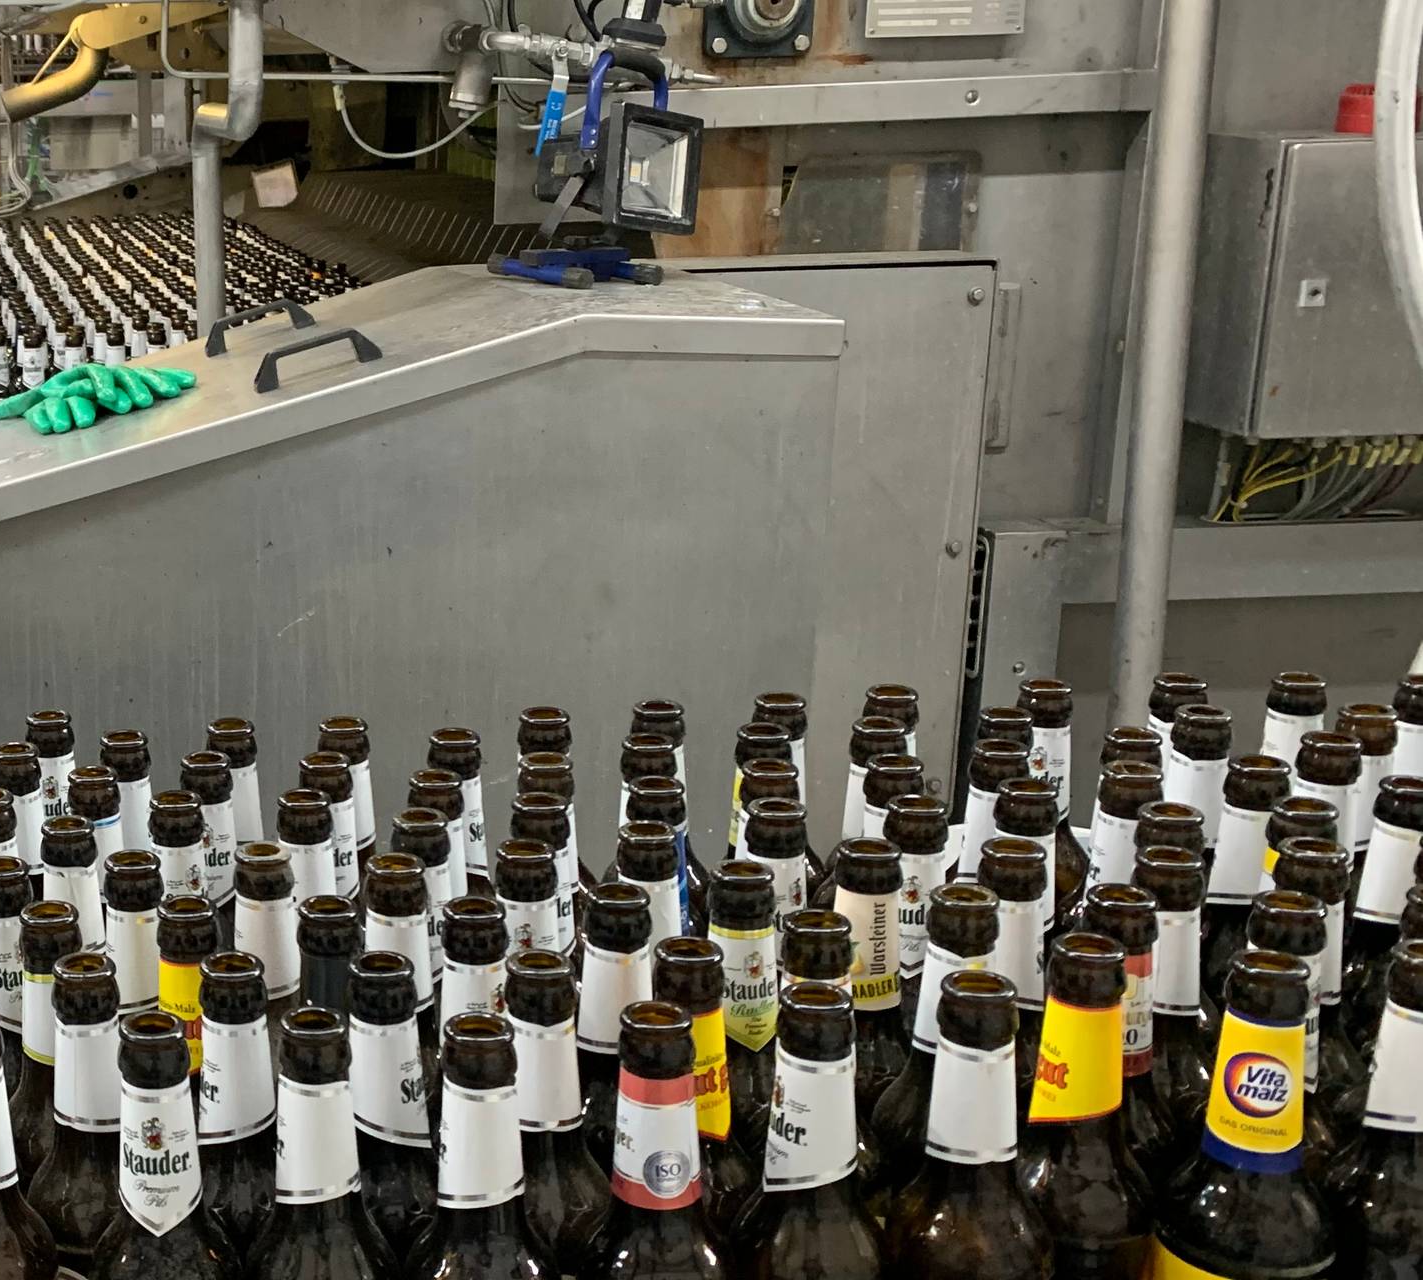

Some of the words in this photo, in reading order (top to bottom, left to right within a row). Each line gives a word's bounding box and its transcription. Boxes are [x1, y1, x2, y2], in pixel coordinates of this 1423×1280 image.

[869, 902, 886, 977] Warsteiner
[1246, 1065, 1287, 1088] Vita
[1237, 1082, 1288, 1103] malz
[1219, 1115, 1239, 1130] DAS
[655, 1163, 682, 1179] ISO
